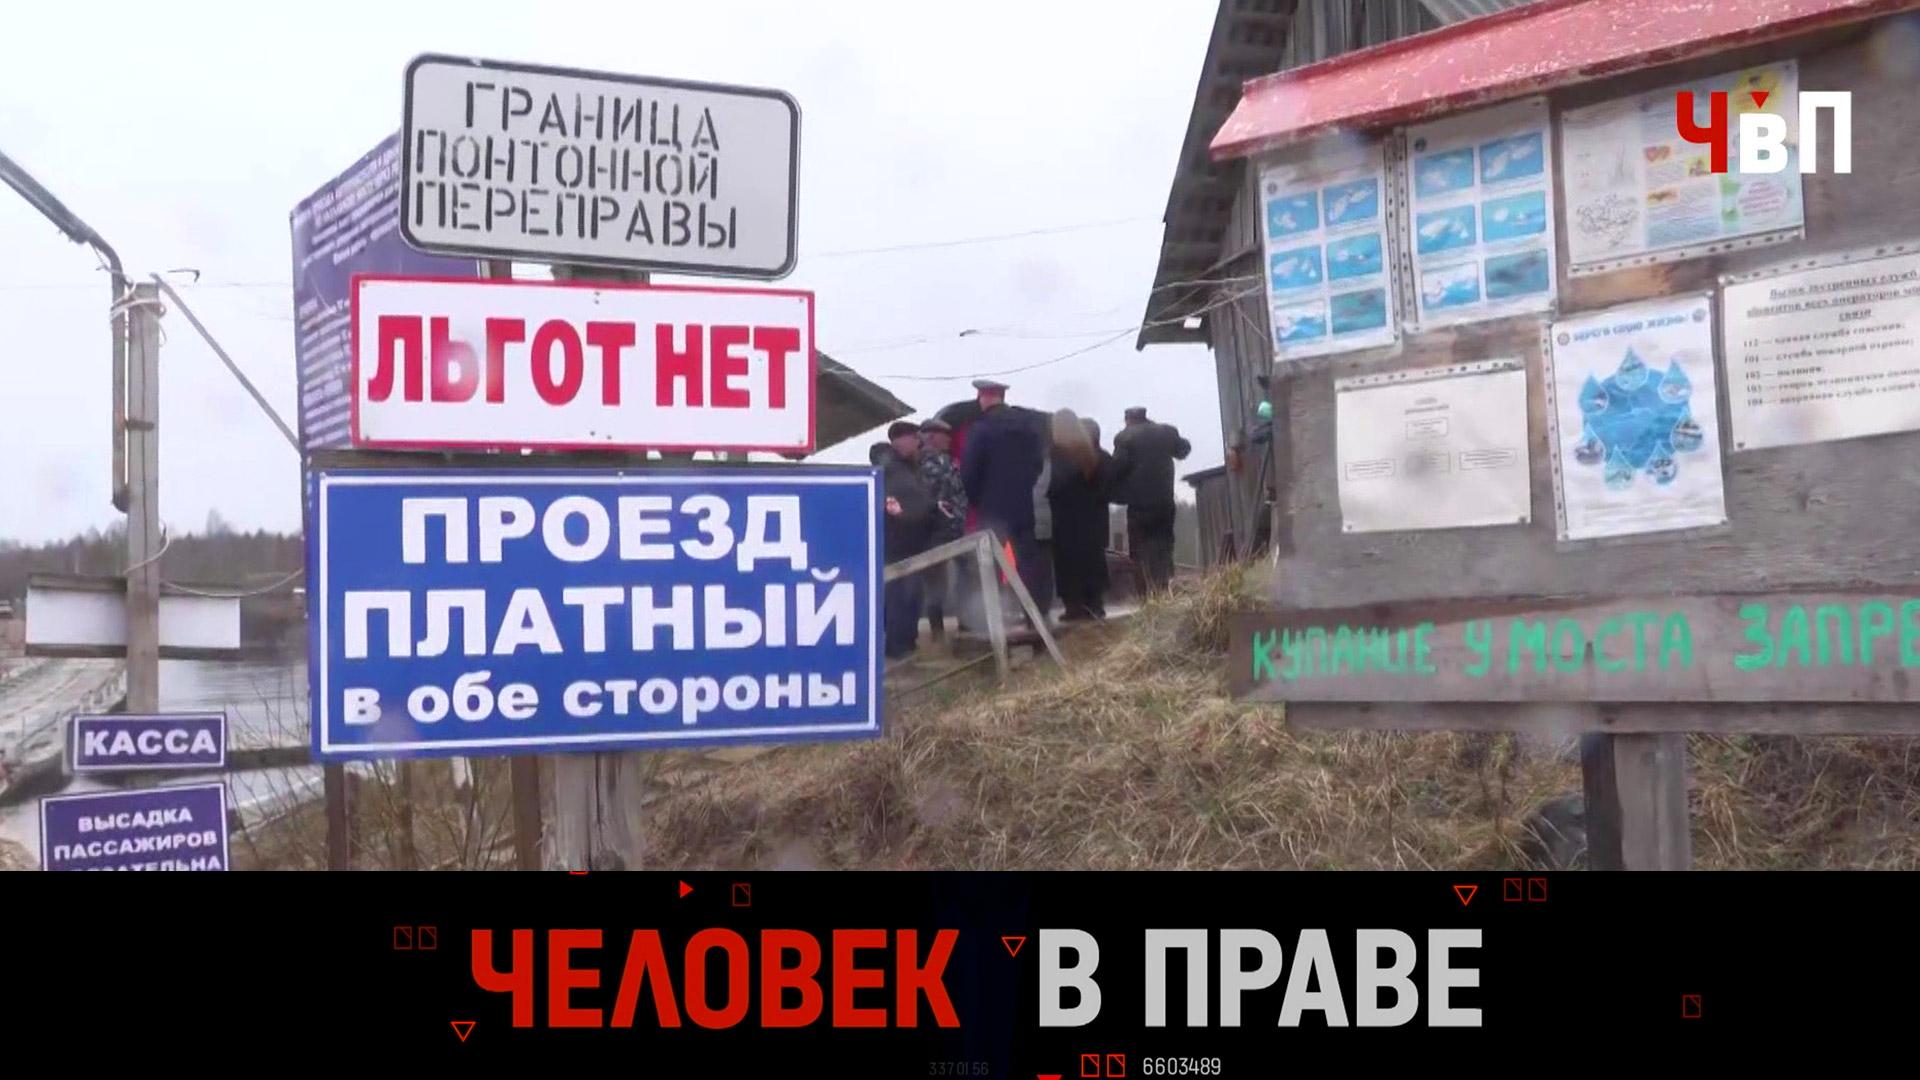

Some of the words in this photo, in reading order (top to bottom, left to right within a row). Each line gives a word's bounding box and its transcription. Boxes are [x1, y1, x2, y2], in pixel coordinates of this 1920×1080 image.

[465, 81, 720, 151] ГРАНИЦА
[416, 129, 718, 200] ПОНТОННОЙ
[416, 181, 737, 249] ПЕРЕПРАВЫ
[368, 315, 636, 405] ЛЬГОТ
[655, 323, 800, 409] НЕТ
[402, 494, 808, 572] ПРОЕЗД
[344, 566, 855, 659] ПЛАТНЫЙ
[1507, 610, 1695, 675] МОСТА
[343, 687, 382, 725] в
[407, 670, 539, 724] обе
[562, 671, 856, 724] стороны
[83, 728, 217, 757] КАССА
[53, 830, 218, 861] ПАССАЖИРОВ
[77, 807, 193, 833] ВЫСАДКА
